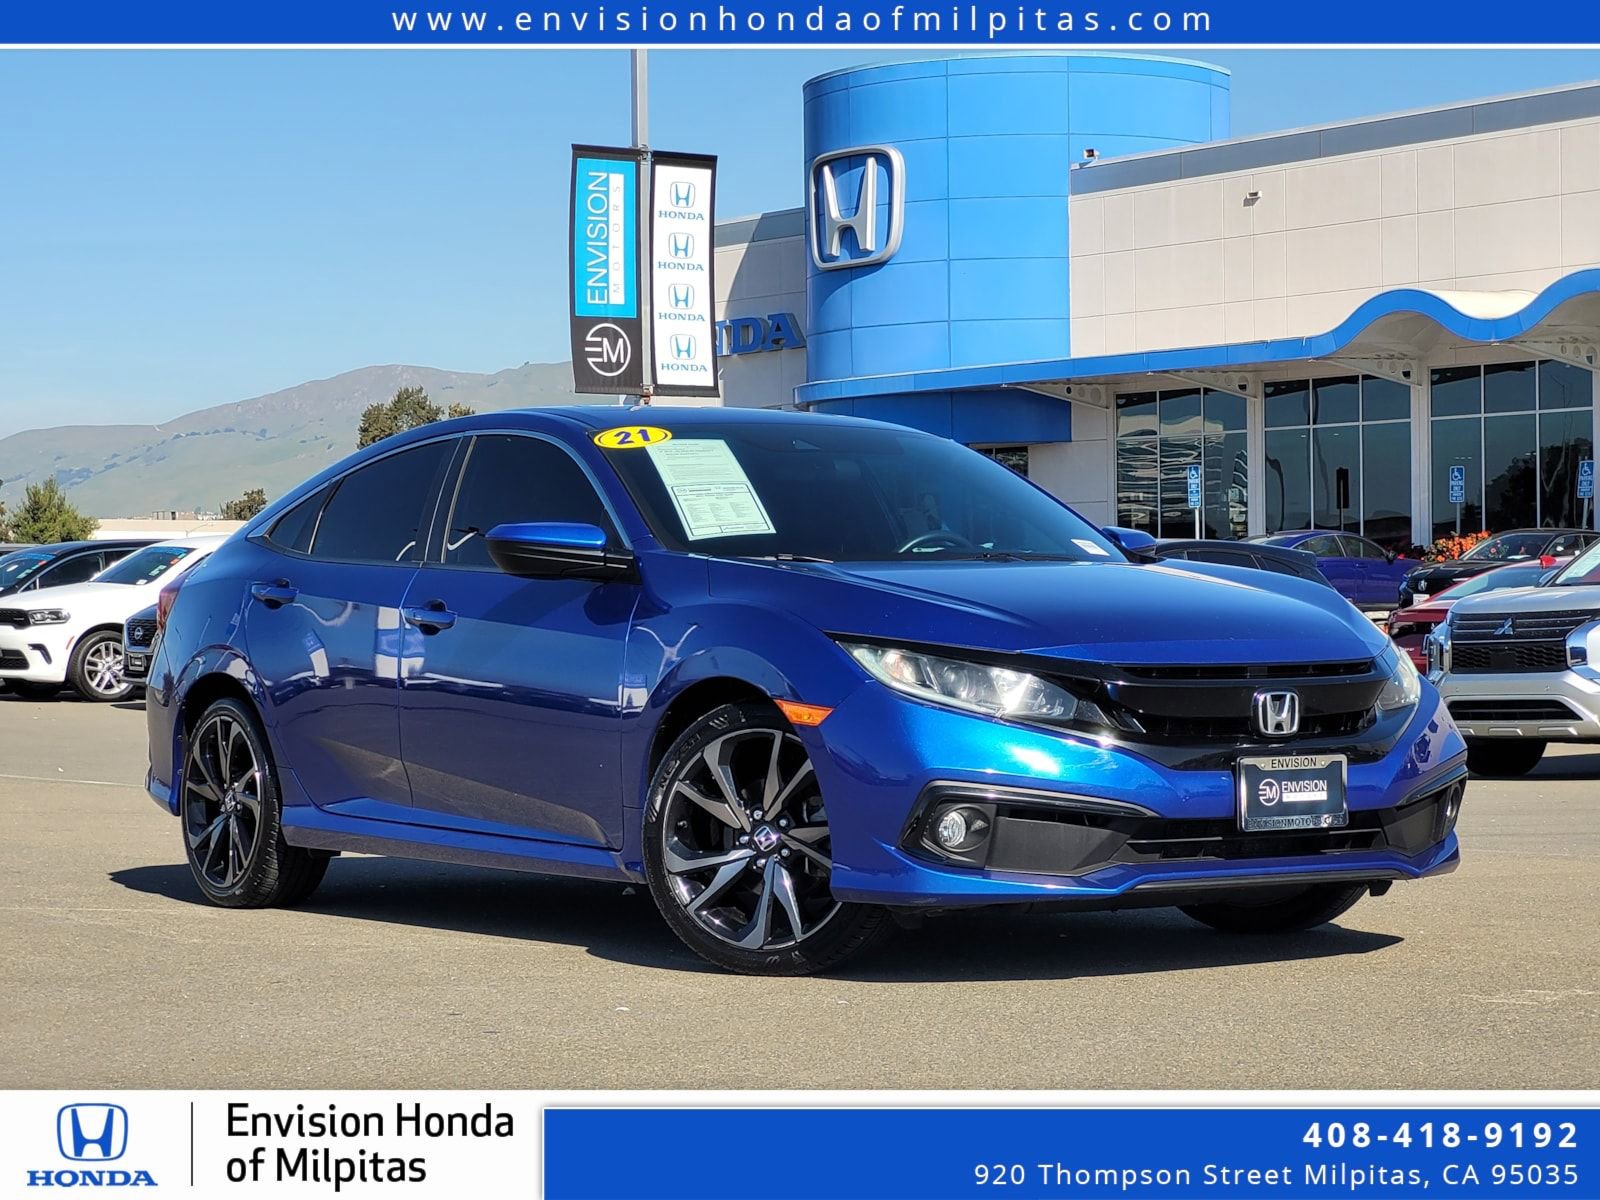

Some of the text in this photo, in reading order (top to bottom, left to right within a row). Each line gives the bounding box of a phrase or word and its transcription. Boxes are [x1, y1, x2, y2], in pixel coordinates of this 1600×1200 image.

[657, 210, 705, 221] HONDA
[586, 171, 609, 305] ENVISION
[612, 185, 622, 294] MOTORS
[657, 261, 705, 272] HONDA
[657, 312, 706, 322] HONDA
[660, 363, 708, 373] HONDA
[614, 429, 651, 445] 21
[1271, 757, 1317, 769] ENVISION
[1281, 780, 1327, 793] ENVISION
